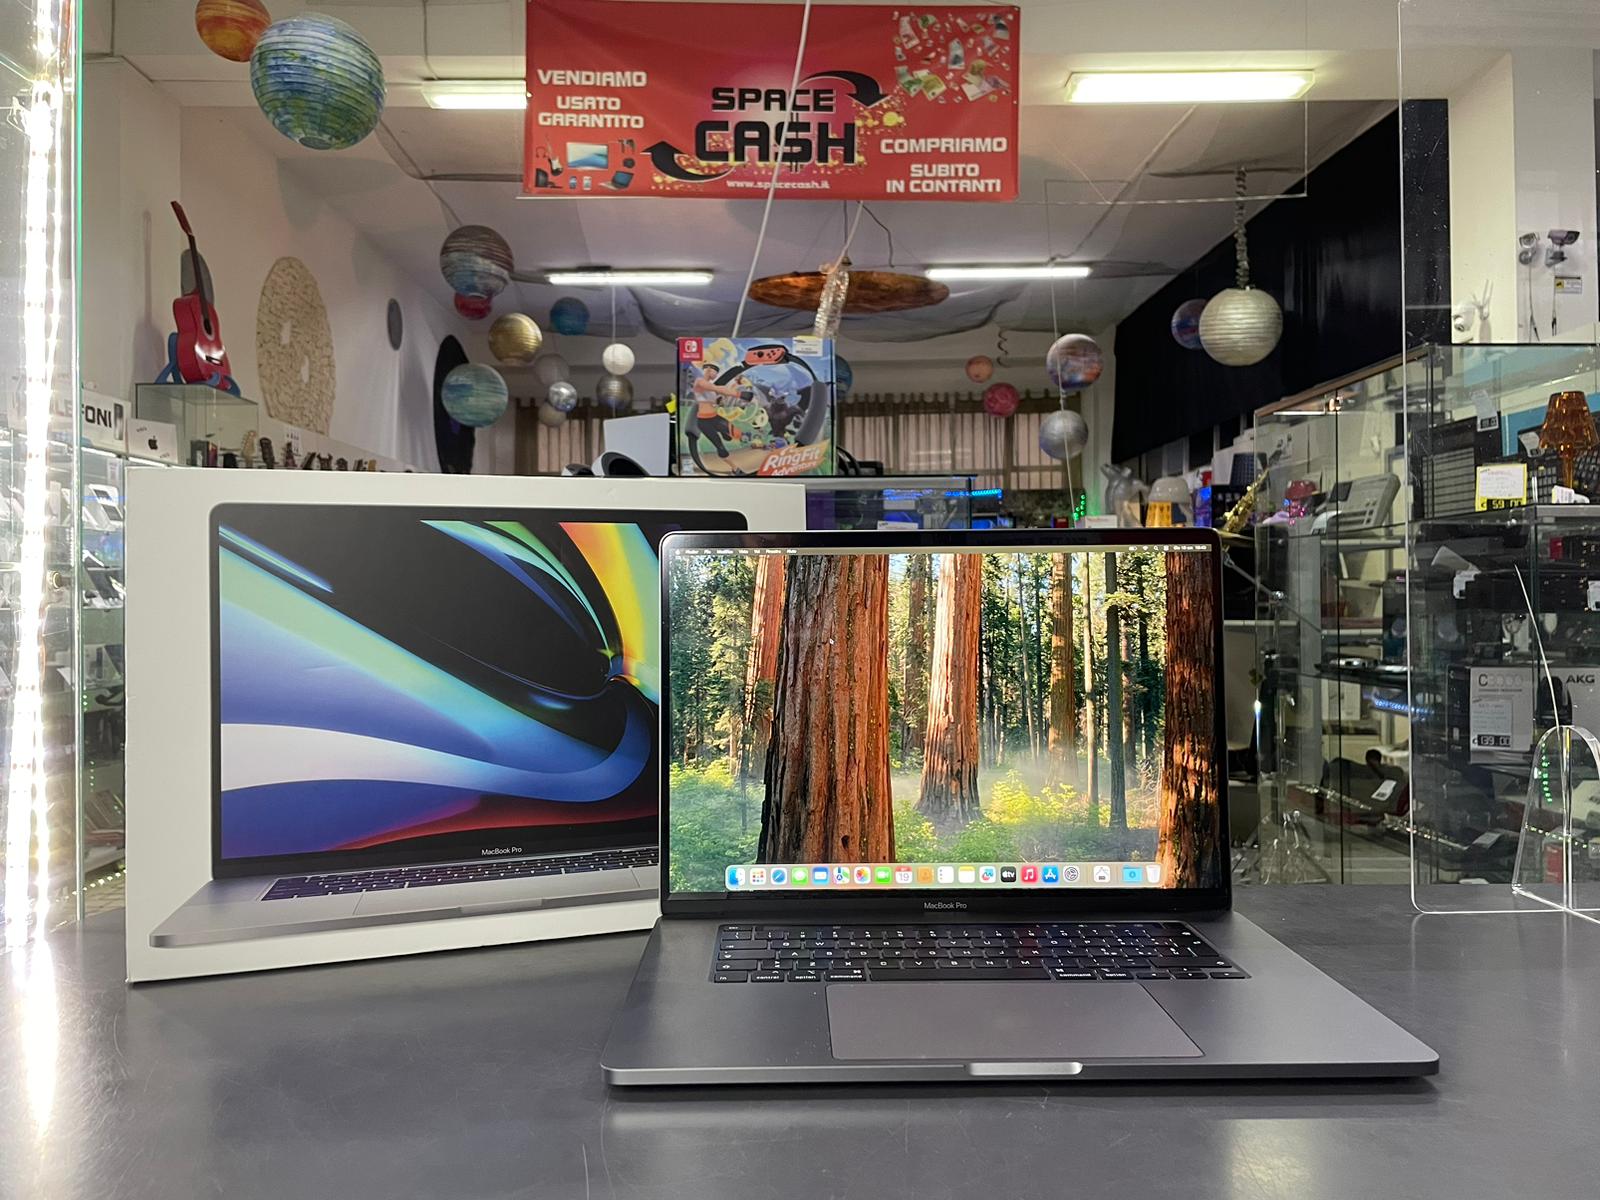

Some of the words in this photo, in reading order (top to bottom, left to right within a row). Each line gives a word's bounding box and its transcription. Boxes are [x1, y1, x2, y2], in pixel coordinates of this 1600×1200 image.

[537, 69, 648, 87] VENDIAMO
[556, 96, 621, 110] USATO
[712, 87, 835, 112] SPACE
[538, 112, 645, 128] GARANTITO
[880, 137, 1008, 154] COMPRIAMO
[910, 163, 980, 178] SUBITO
[886, 179, 905, 193] IN
[909, 179, 1001, 193] CONTANTI
[1566, 674, 1595, 684] AKG
[481, 847, 511, 856] MacBook
[955, 901, 968, 909] Pro
